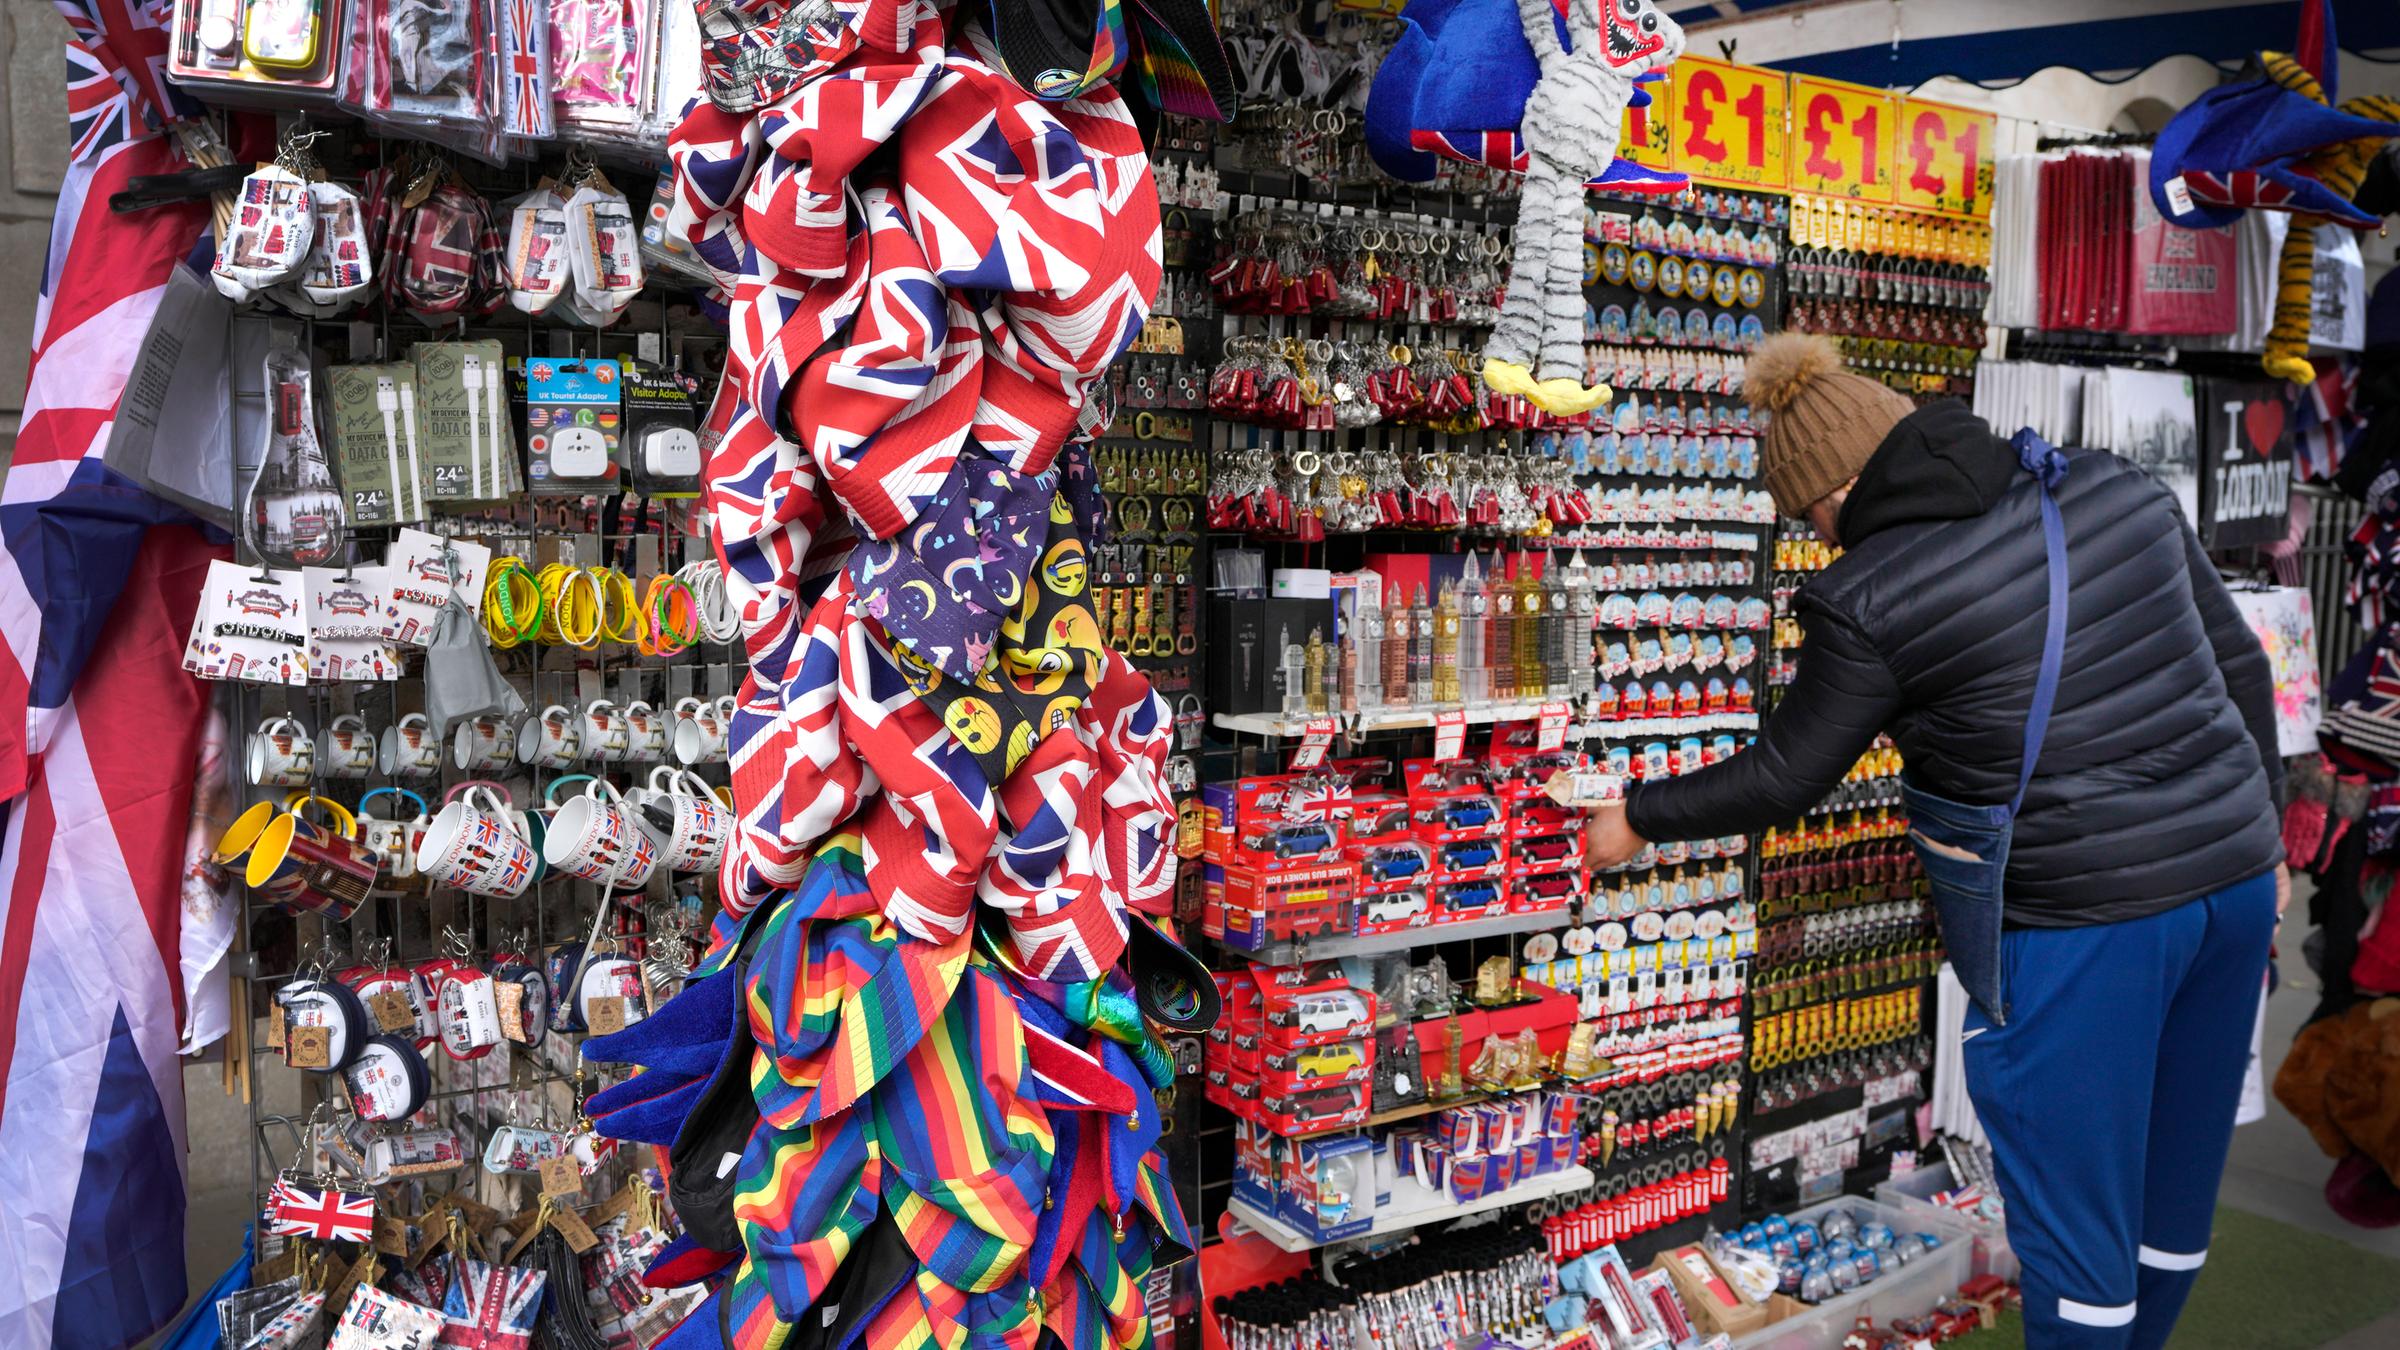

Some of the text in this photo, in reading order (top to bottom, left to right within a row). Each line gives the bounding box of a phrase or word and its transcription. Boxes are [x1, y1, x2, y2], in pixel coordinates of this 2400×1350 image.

[1683, 69, 1765, 167] £1
[1803, 92, 1878, 185] £1
[1909, 111, 1980, 199] £1
[2145, 264, 2217, 293] ENGLAND
[577, 393, 608, 401] Adaptor
[631, 387, 656, 398] Visitor
[432, 422, 460, 436] DATA
[356, 433, 377, 441] DEVICE
[349, 446, 378, 461] DATA
[2214, 460, 2291, 523] LONDON
[404, 587, 446, 607] LOND
[498, 573, 513, 624] LONDON
[1542, 702, 1566, 714] sale
[1309, 718, 1332, 731] sale
[1438, 711, 1462, 723] sale
[450, 822, 471, 864] LONDON
[580, 818, 601, 857] LONDON
[677, 816, 691, 855] LONDON
[1266, 874, 1282, 884] BOX
[1283, 871, 1308, 883] MONEY
[1309, 870, 1326, 880] BUS
